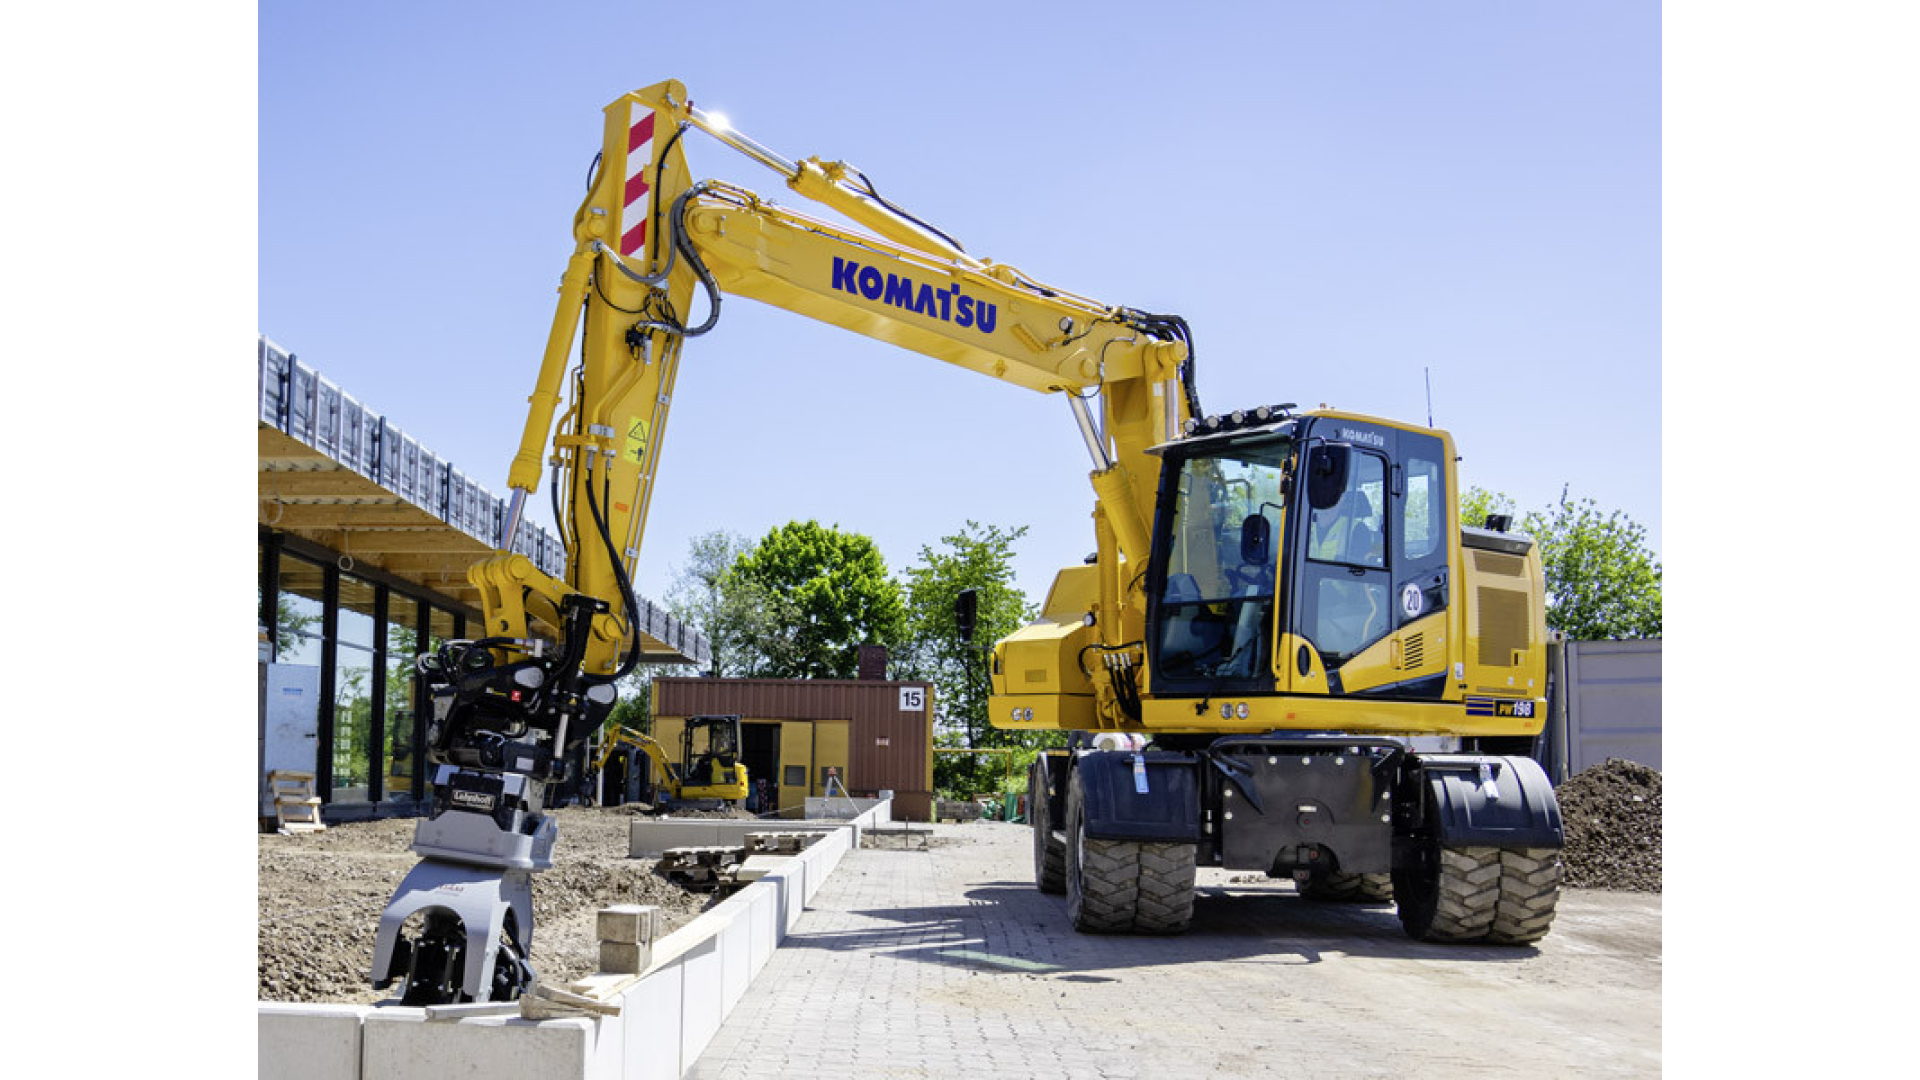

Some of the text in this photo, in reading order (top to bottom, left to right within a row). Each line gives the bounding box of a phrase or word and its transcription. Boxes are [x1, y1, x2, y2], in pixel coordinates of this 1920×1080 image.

[832, 256, 997, 334] KOMATSU
[1342, 428, 1384, 447] KOMATSU
[1406, 589, 1420, 611] 20
[903, 691, 921, 707] 15
